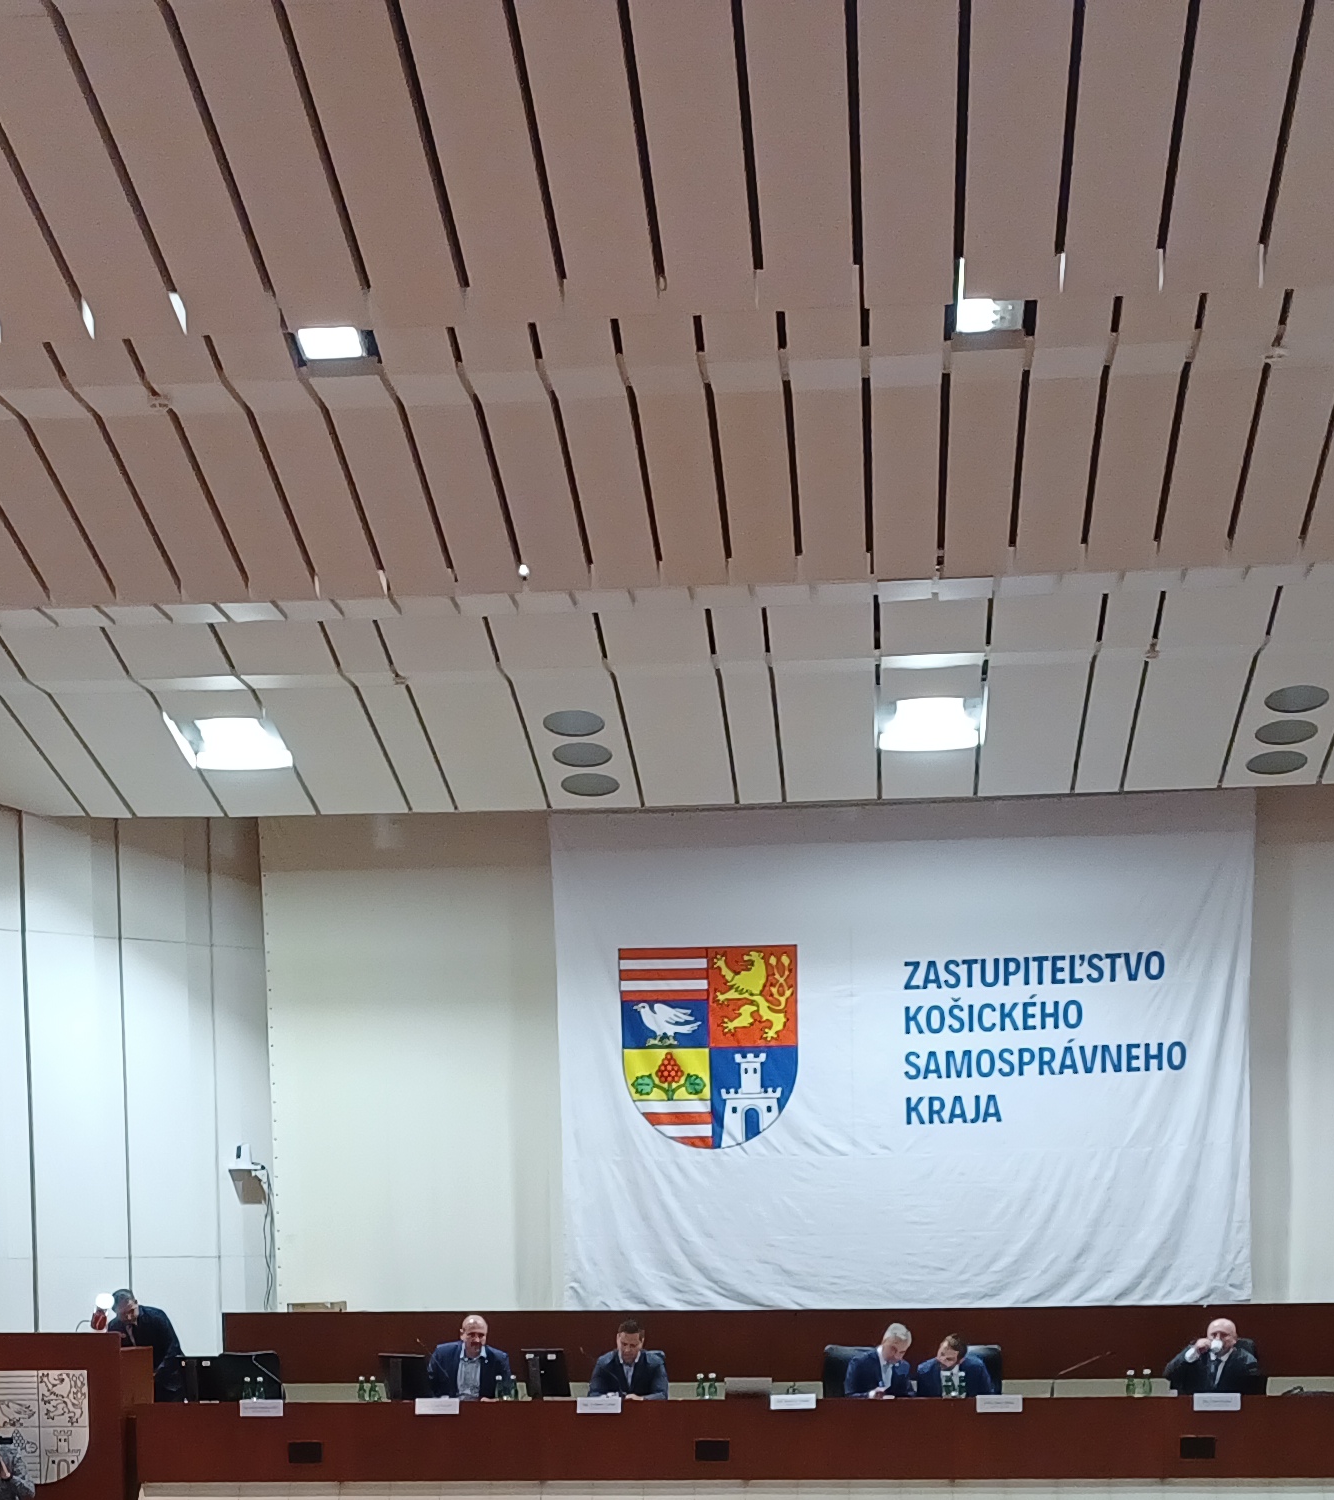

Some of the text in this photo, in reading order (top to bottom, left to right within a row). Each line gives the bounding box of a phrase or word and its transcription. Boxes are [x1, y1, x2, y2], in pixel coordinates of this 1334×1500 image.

[903, 950, 1165, 990] ZASTUPITEĽSTVO
[903, 993, 1083, 1035] KOŠICKÉHO
[903, 1037, 1187, 1080] SAMOSPRÁVNEHO
[905, 1094, 1002, 1125] KRAJA
